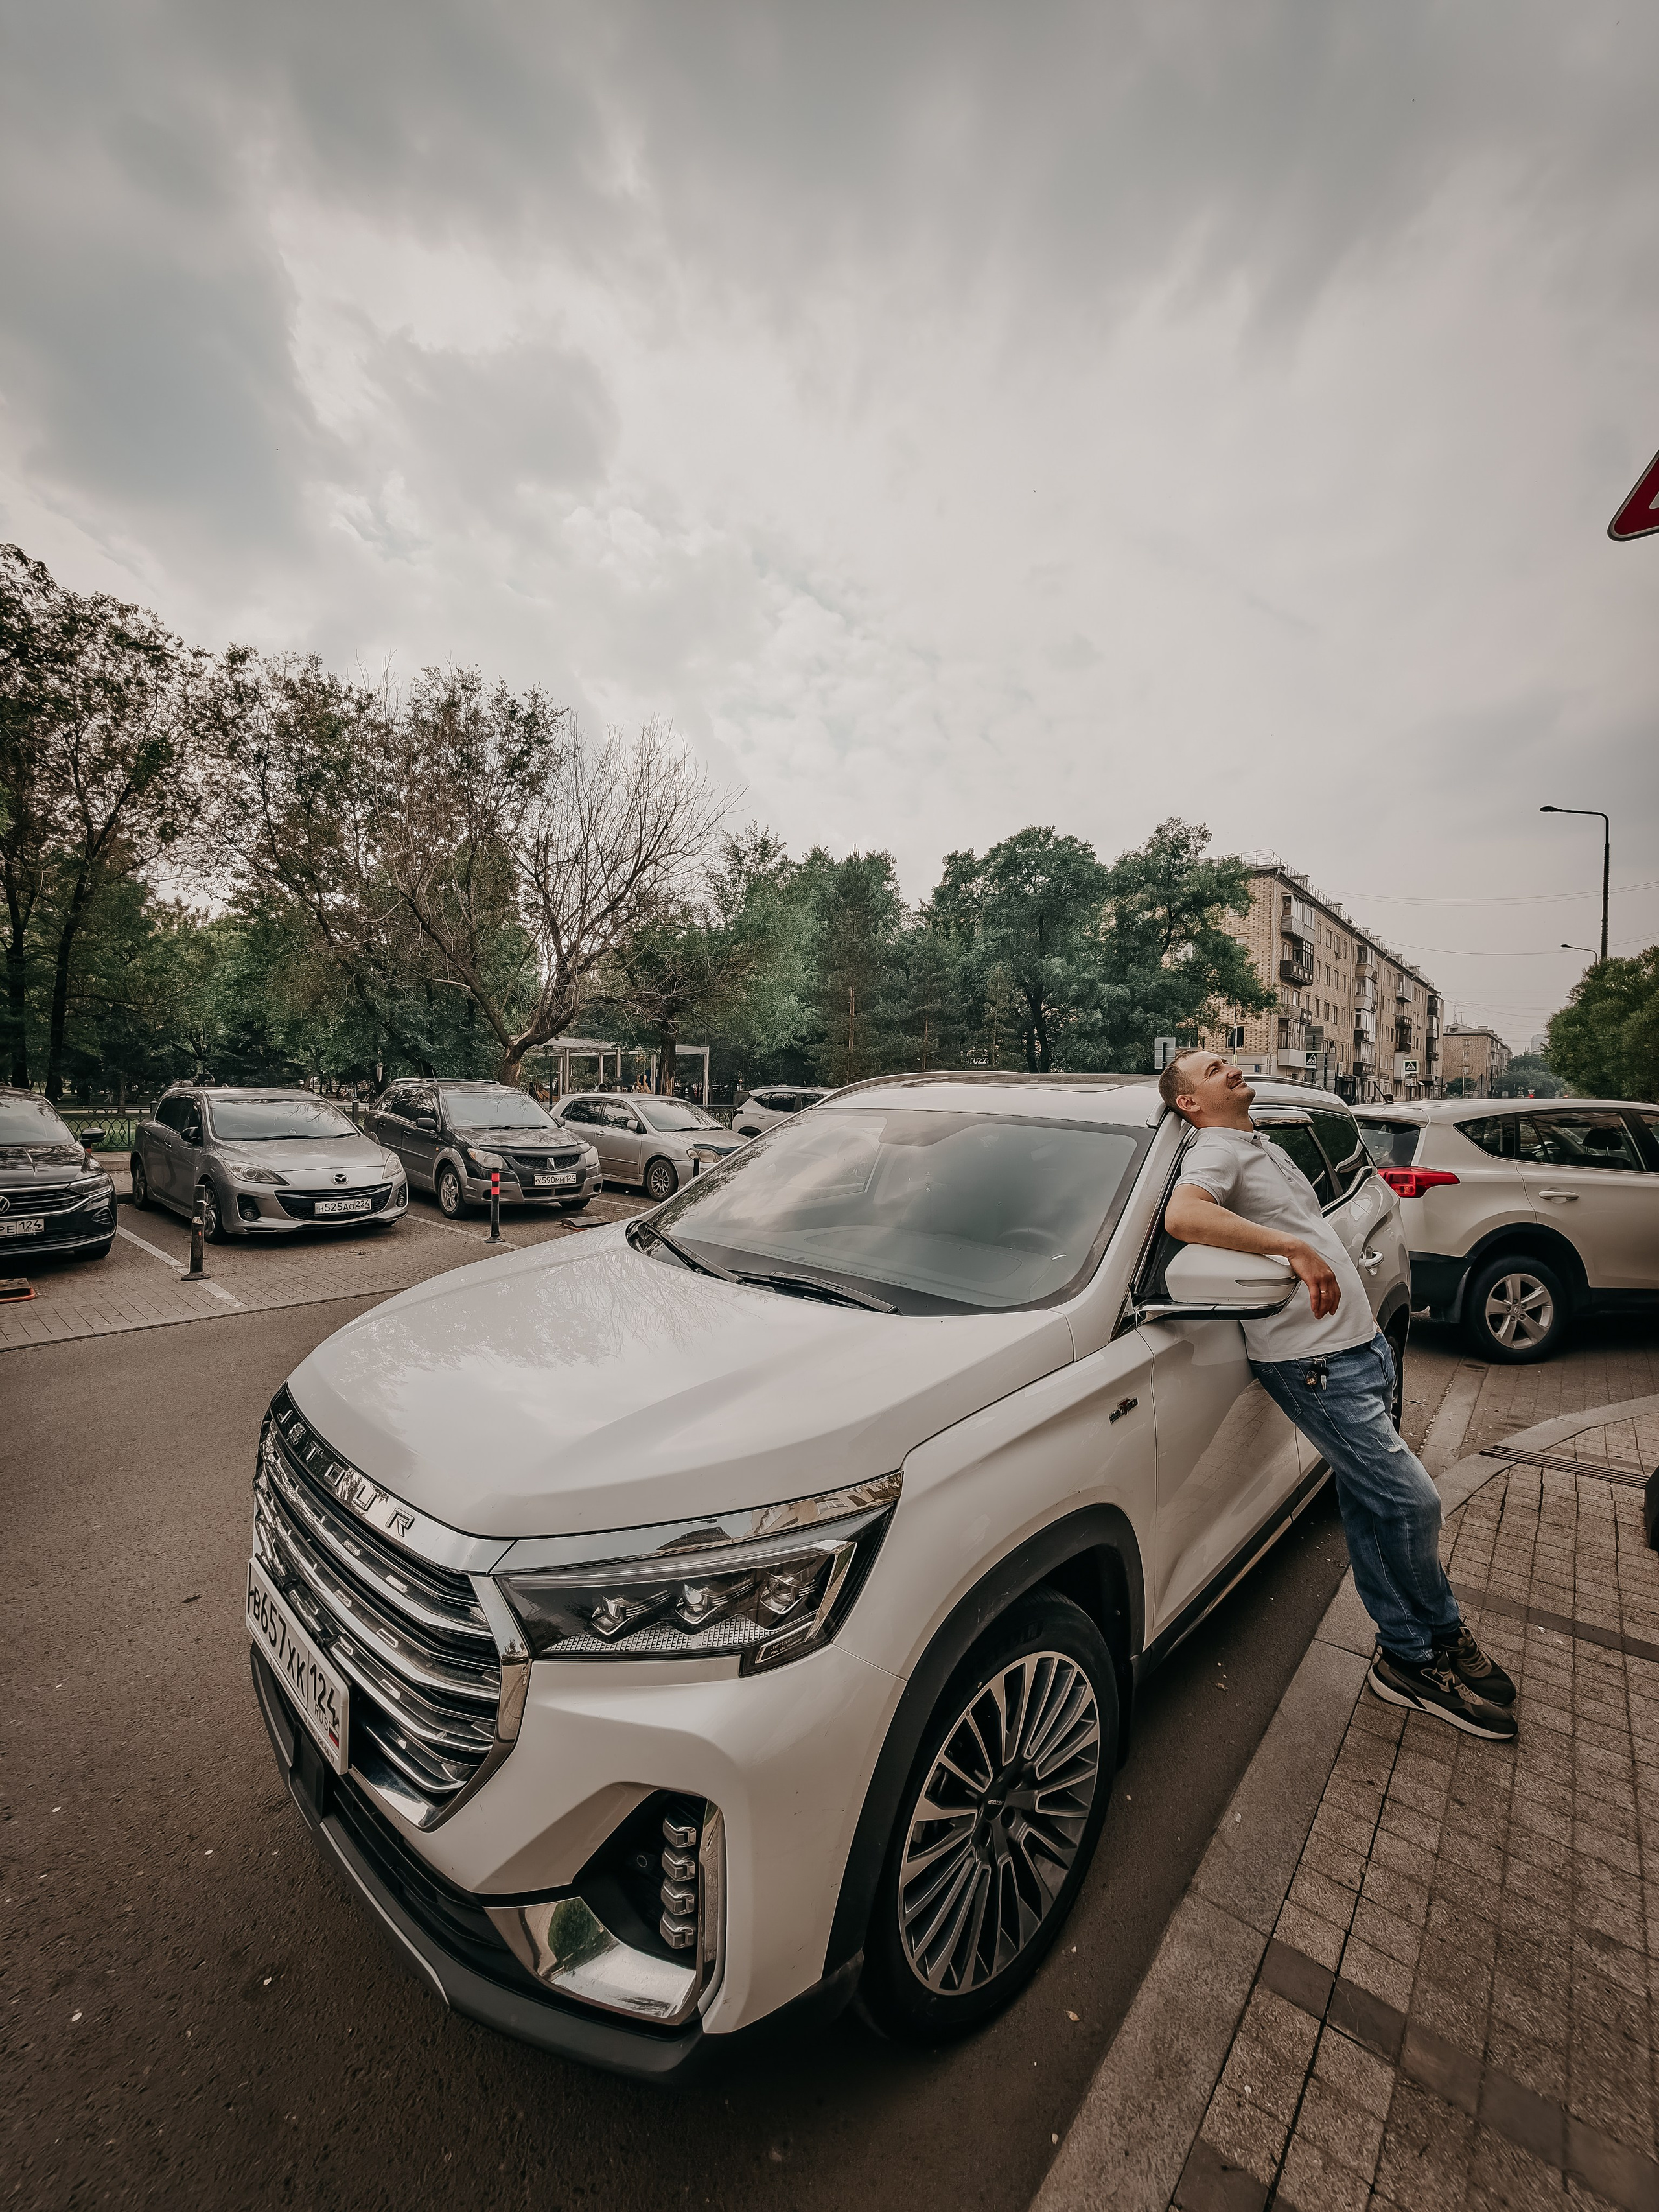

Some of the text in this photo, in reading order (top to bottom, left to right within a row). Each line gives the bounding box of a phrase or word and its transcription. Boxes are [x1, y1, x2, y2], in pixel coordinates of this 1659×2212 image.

[18, 1220, 42, 1230] 124
[253, 1585, 305, 1697] В657ХК
[310, 1662, 339, 1727] 124
[314, 1702, 329, 1732] RUS
